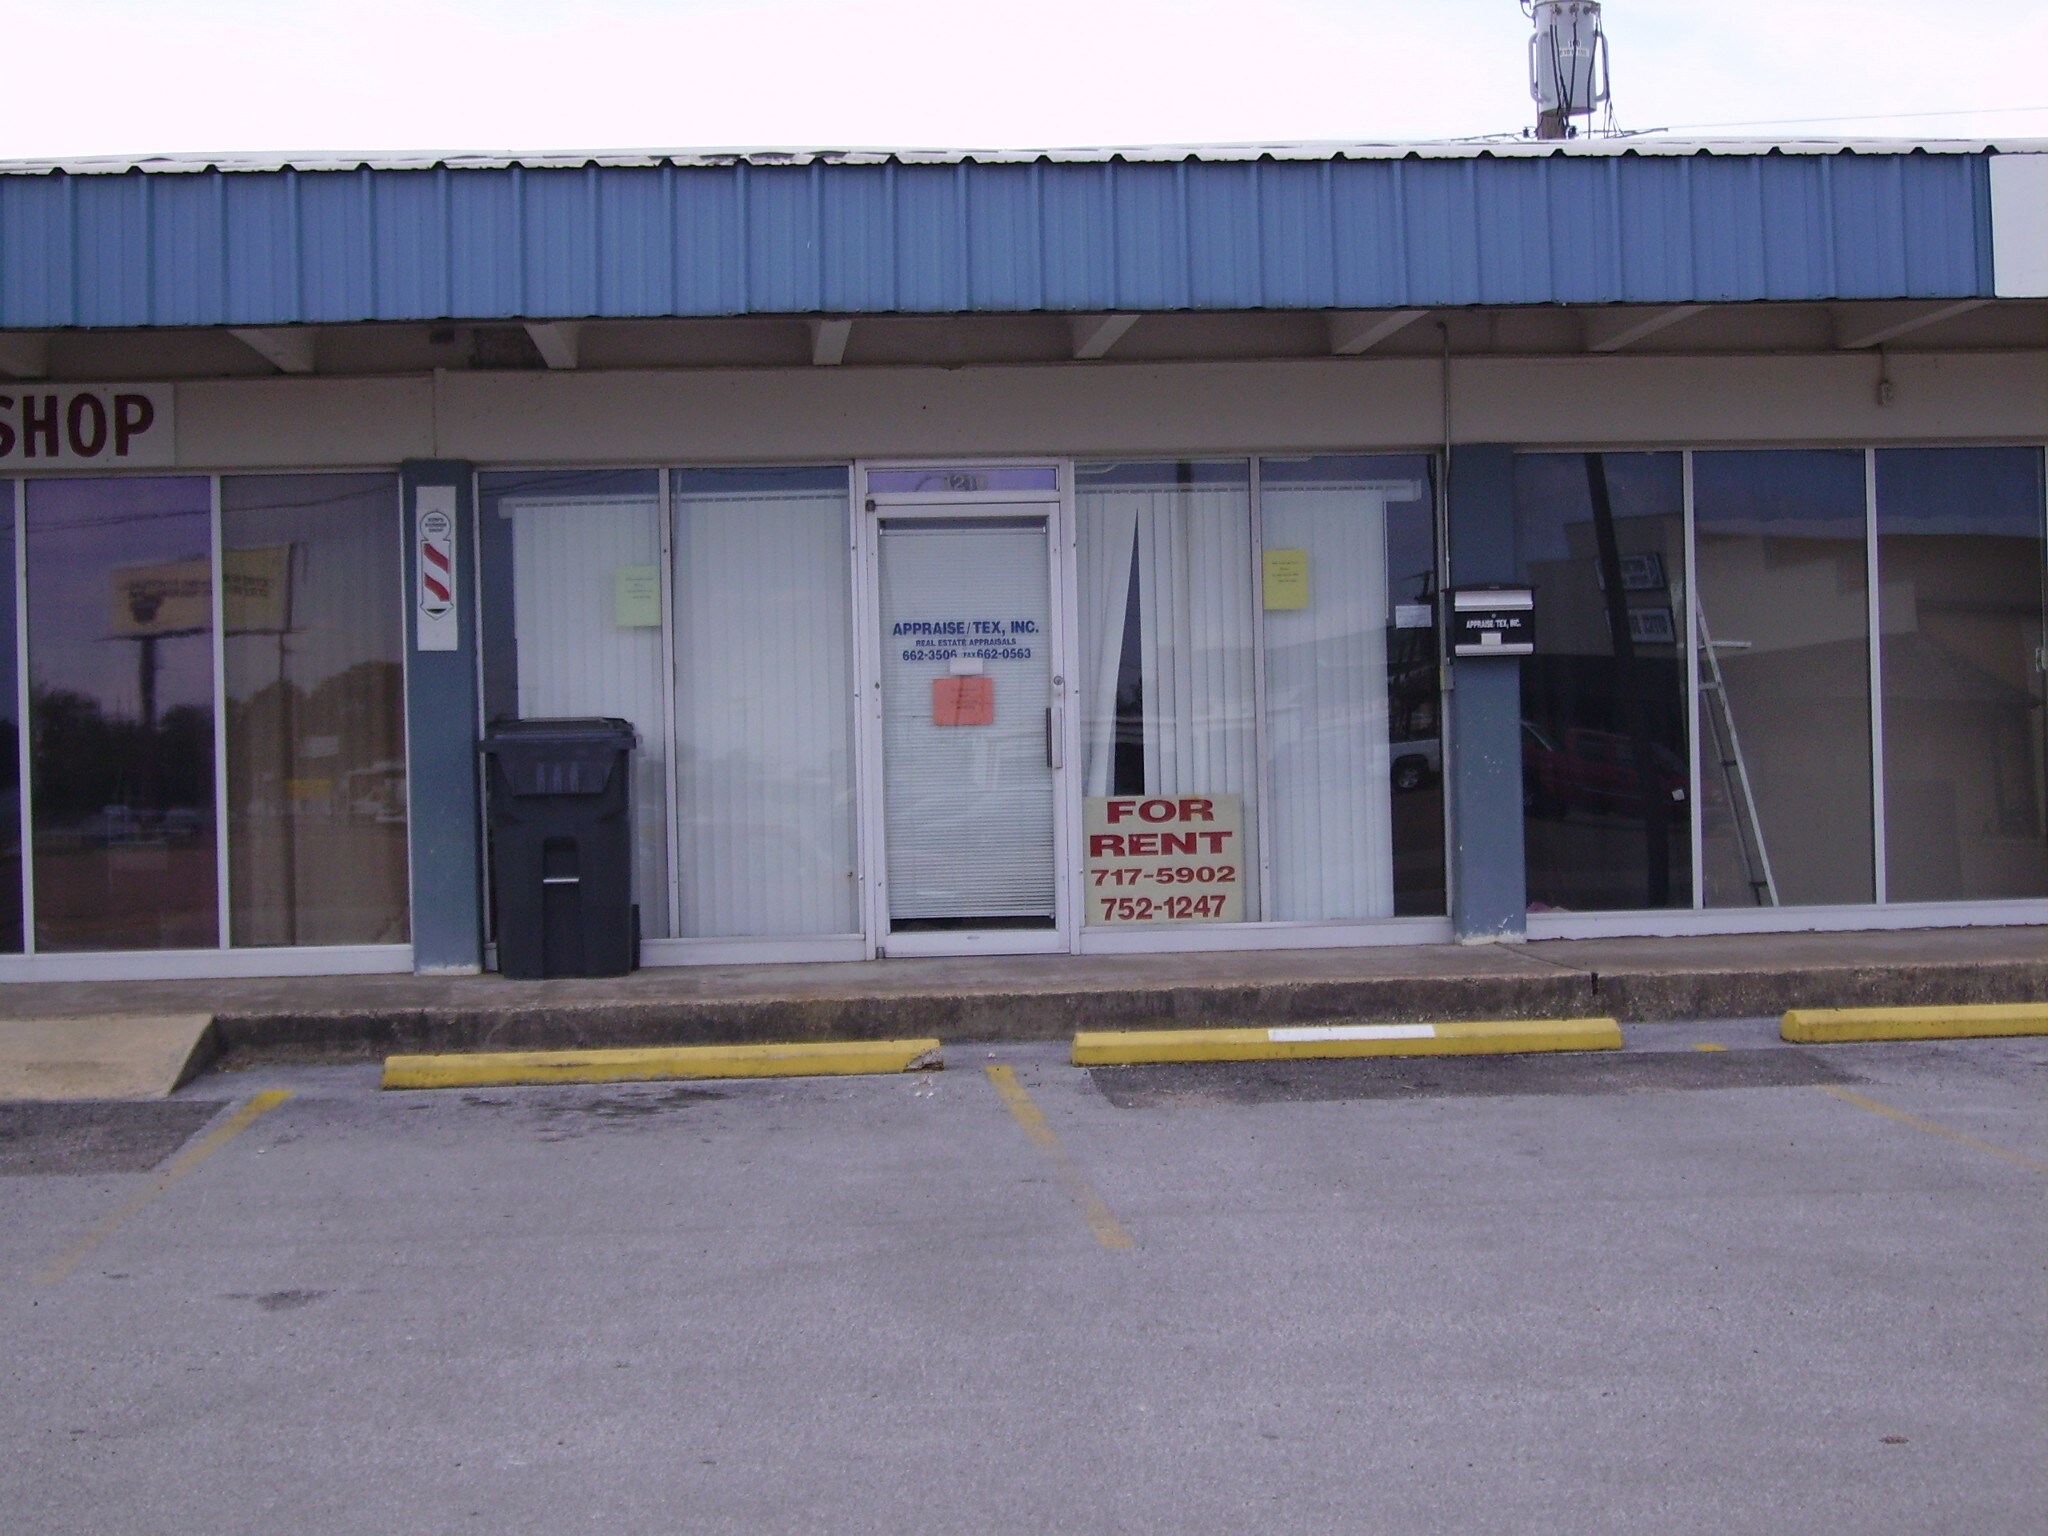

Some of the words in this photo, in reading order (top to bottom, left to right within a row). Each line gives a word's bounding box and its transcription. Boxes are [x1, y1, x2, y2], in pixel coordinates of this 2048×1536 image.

[0, 393, 154, 458] SHOP
[893, 622, 1006, 636] APPRAISE/TEX,
[1011, 620, 1040, 633] INC.
[916, 639, 936, 647] REAL
[938, 639, 966, 647] ESTATE
[969, 638, 1016, 646] APPRAISALS
[902, 650, 957, 661] 662-3506
[977, 648, 1031, 659] 662-0563
[1107, 799, 1215, 824] FOR
[1089, 831, 1233, 858] RENT
[1091, 866, 1236, 887] 717-5902
[1100, 895, 1226, 921] 752-1247
